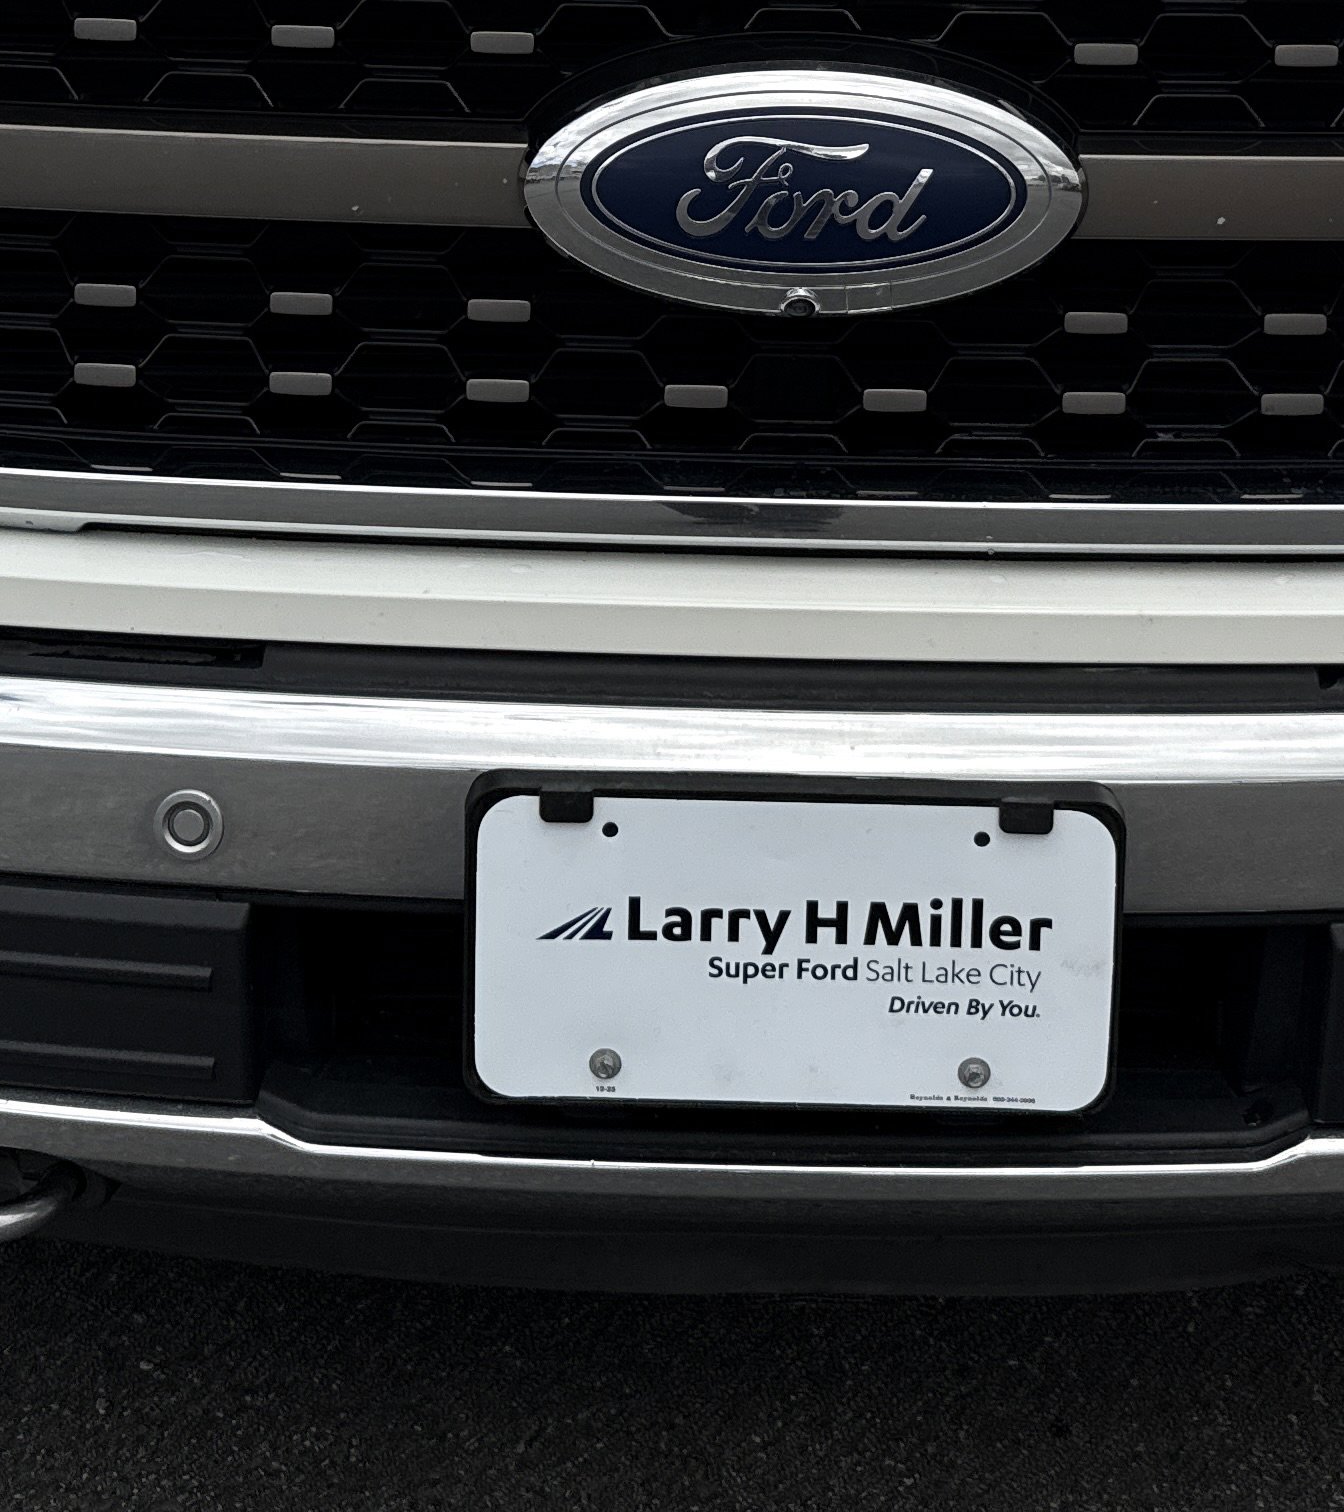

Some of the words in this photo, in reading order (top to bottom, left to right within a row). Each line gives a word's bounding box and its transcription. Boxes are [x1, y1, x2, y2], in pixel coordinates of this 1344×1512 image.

[676, 135, 935, 242] Ford
[627, 895, 792, 956] Larry
[804, 899, 849, 945] H
[862, 897, 1053, 952] Miller
[707, 955, 790, 986] Super
[796, 956, 859, 982] Ford
[865, 957, 914, 984] Salt
[921, 959, 982, 986] Lake
[989, 962, 1043, 994] City
[887, 994, 960, 1016] Driven
[965, 998, 995, 1021] By
[997, 999, 1042, 1019] You.
